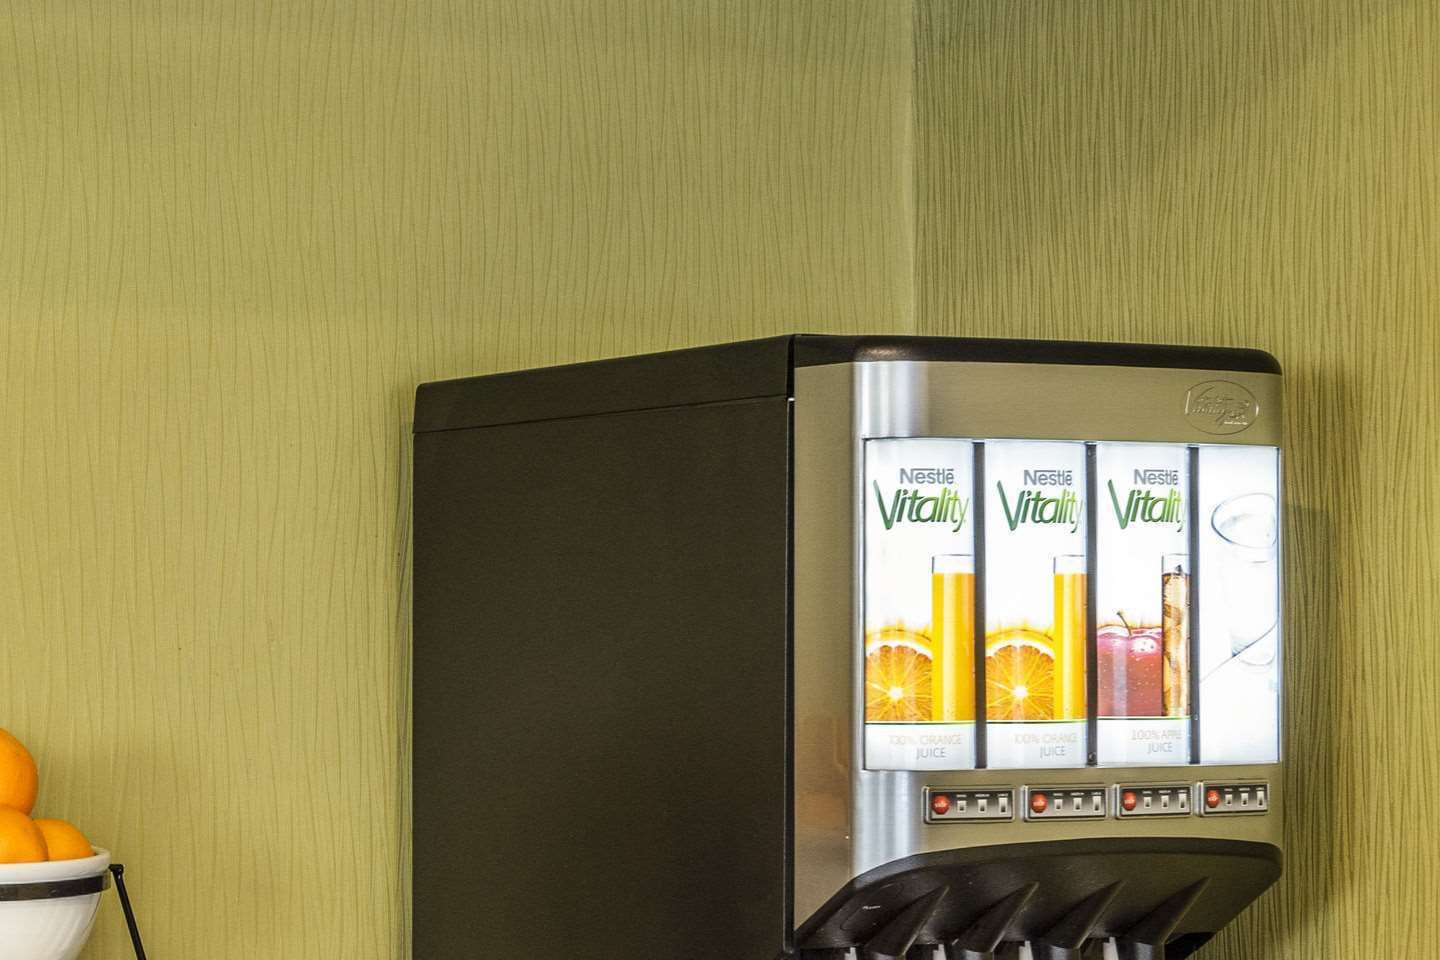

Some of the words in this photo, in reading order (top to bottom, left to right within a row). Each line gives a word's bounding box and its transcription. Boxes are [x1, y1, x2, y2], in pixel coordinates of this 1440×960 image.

[873, 479, 969, 533] Vitality
[997, 479, 1083, 534] Vitality
[916, 747, 947, 760] JUICE
[1039, 746, 1066, 759] JUICE
[1146, 741, 1173, 754] JUICE
